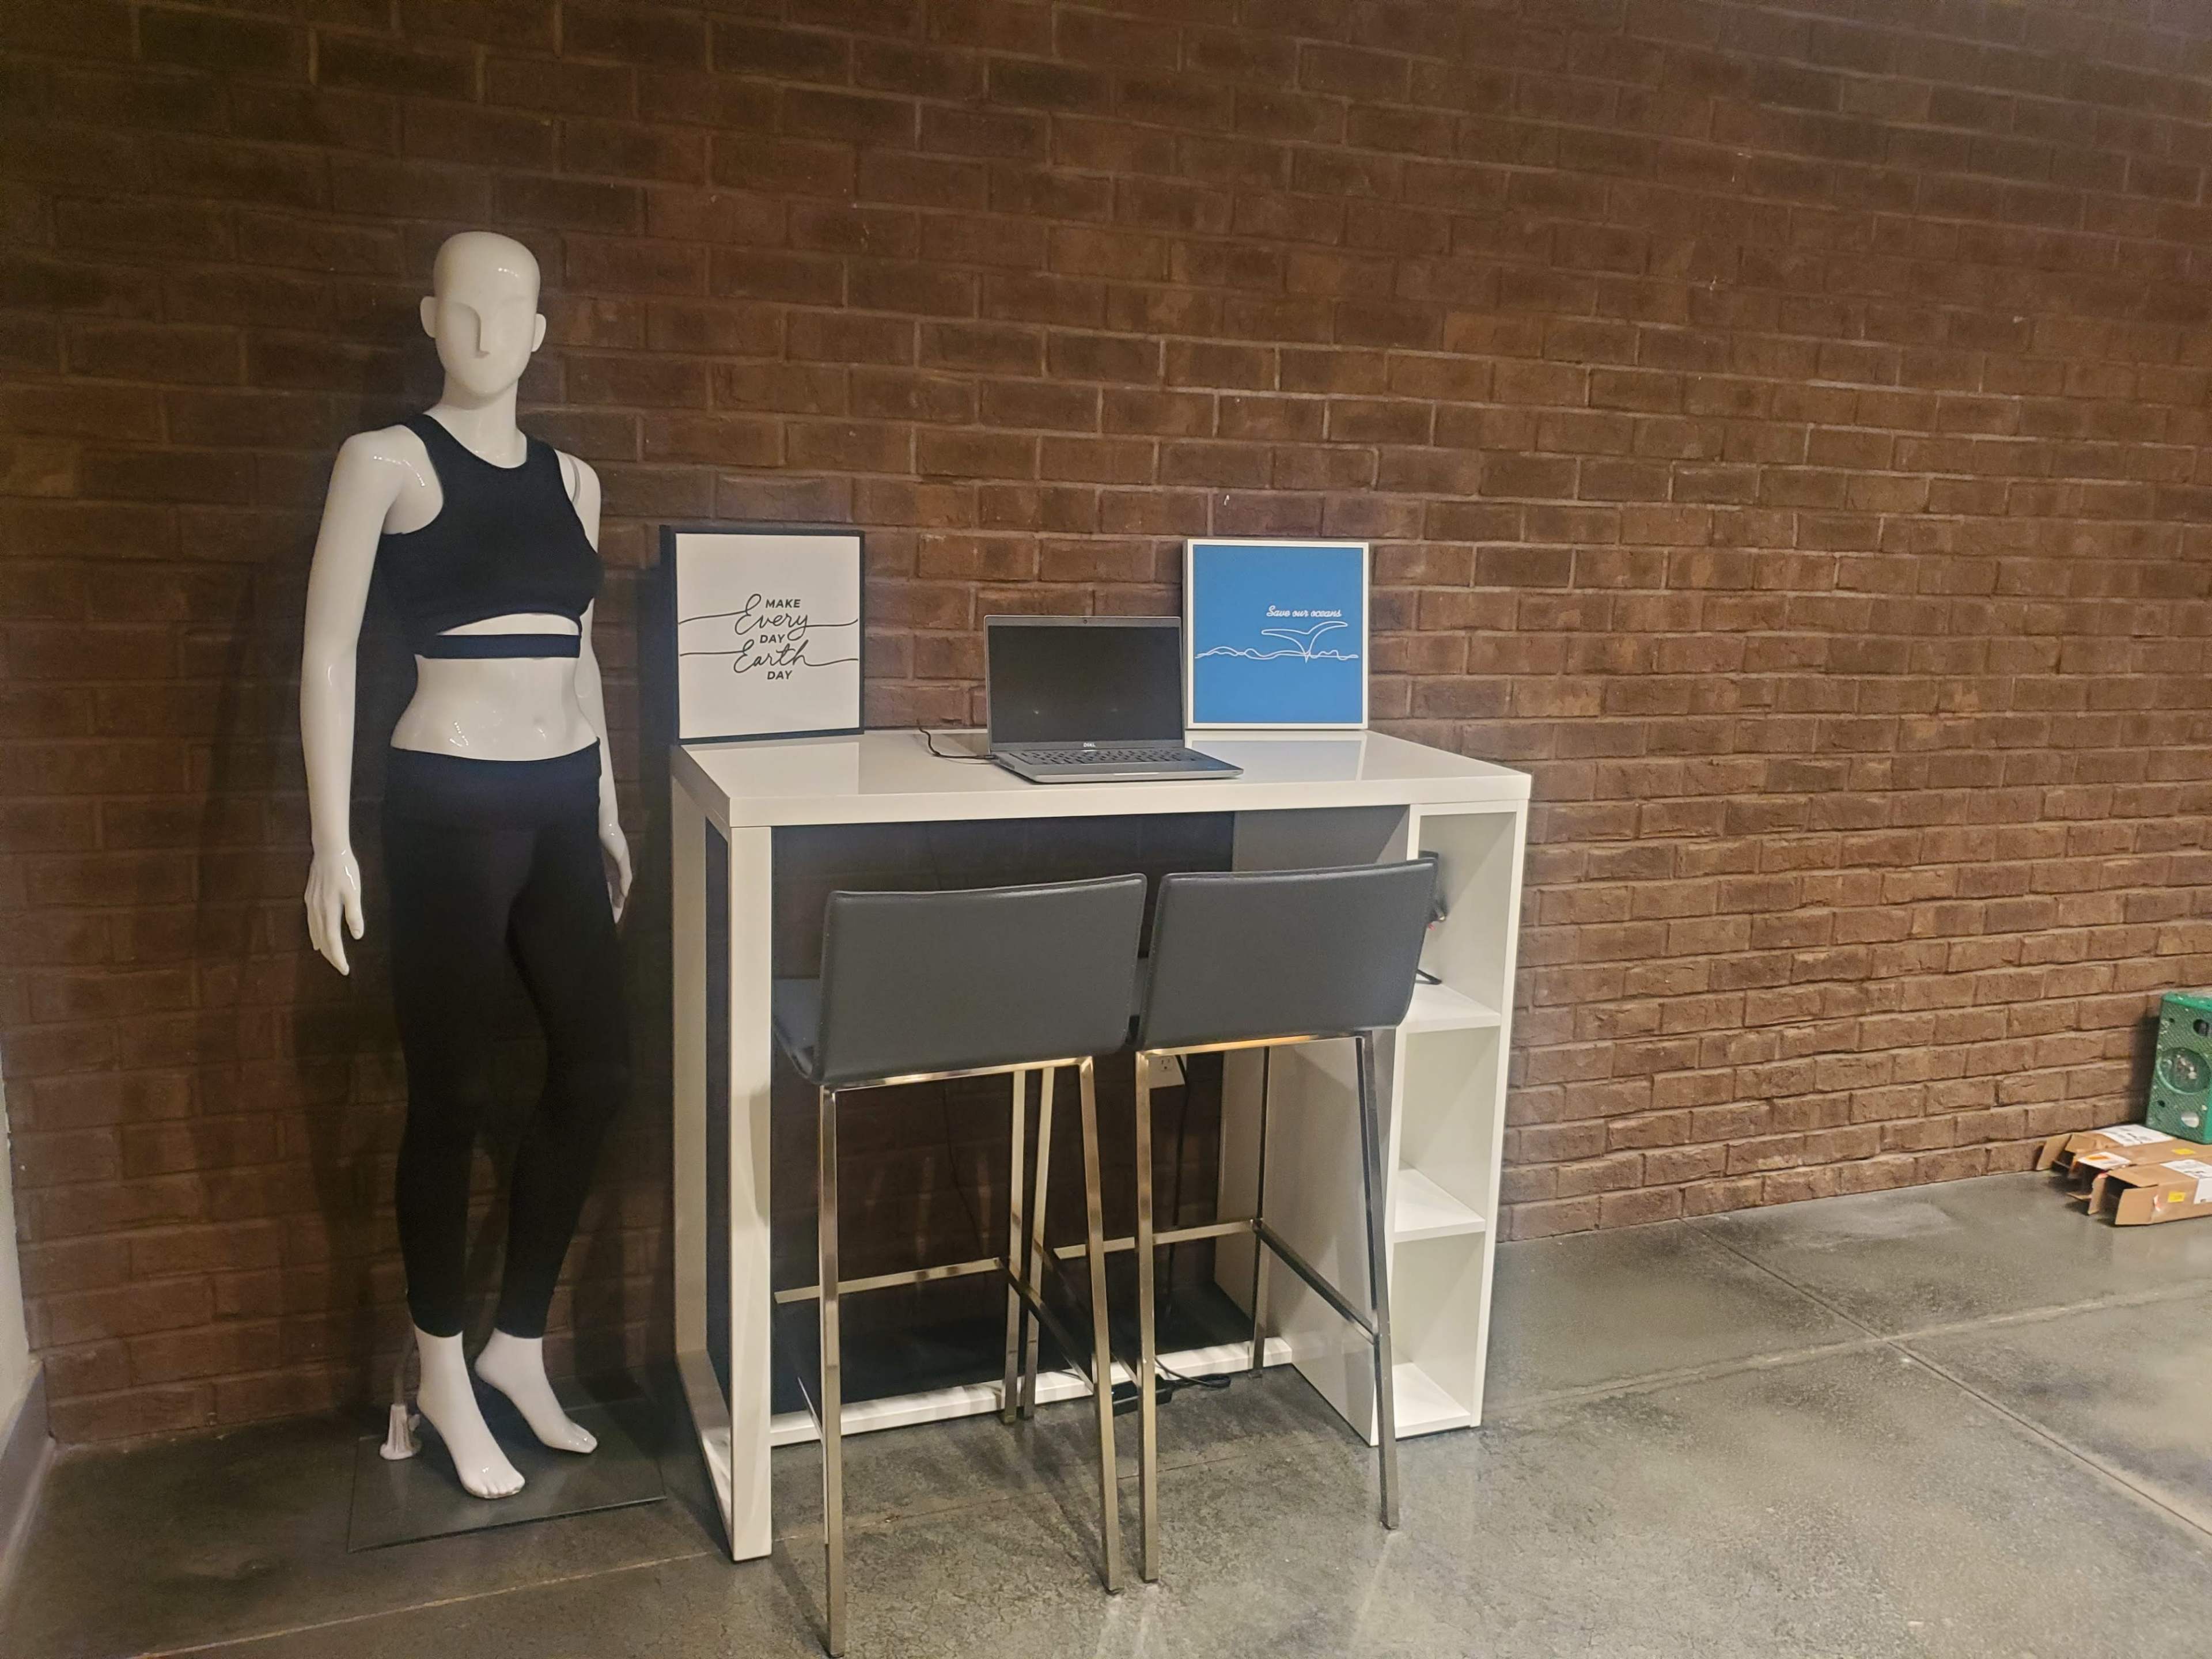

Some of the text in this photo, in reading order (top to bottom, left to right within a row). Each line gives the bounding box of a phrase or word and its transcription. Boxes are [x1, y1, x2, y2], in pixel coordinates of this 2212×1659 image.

[765, 599, 801, 608] MAKE
[734, 593, 808, 641] Every
[1266, 605, 1342, 618] Save our oceans
[759, 634, 786, 644] DAY
[733, 639, 809, 673] Earth
[766, 670, 793, 680] DAY
